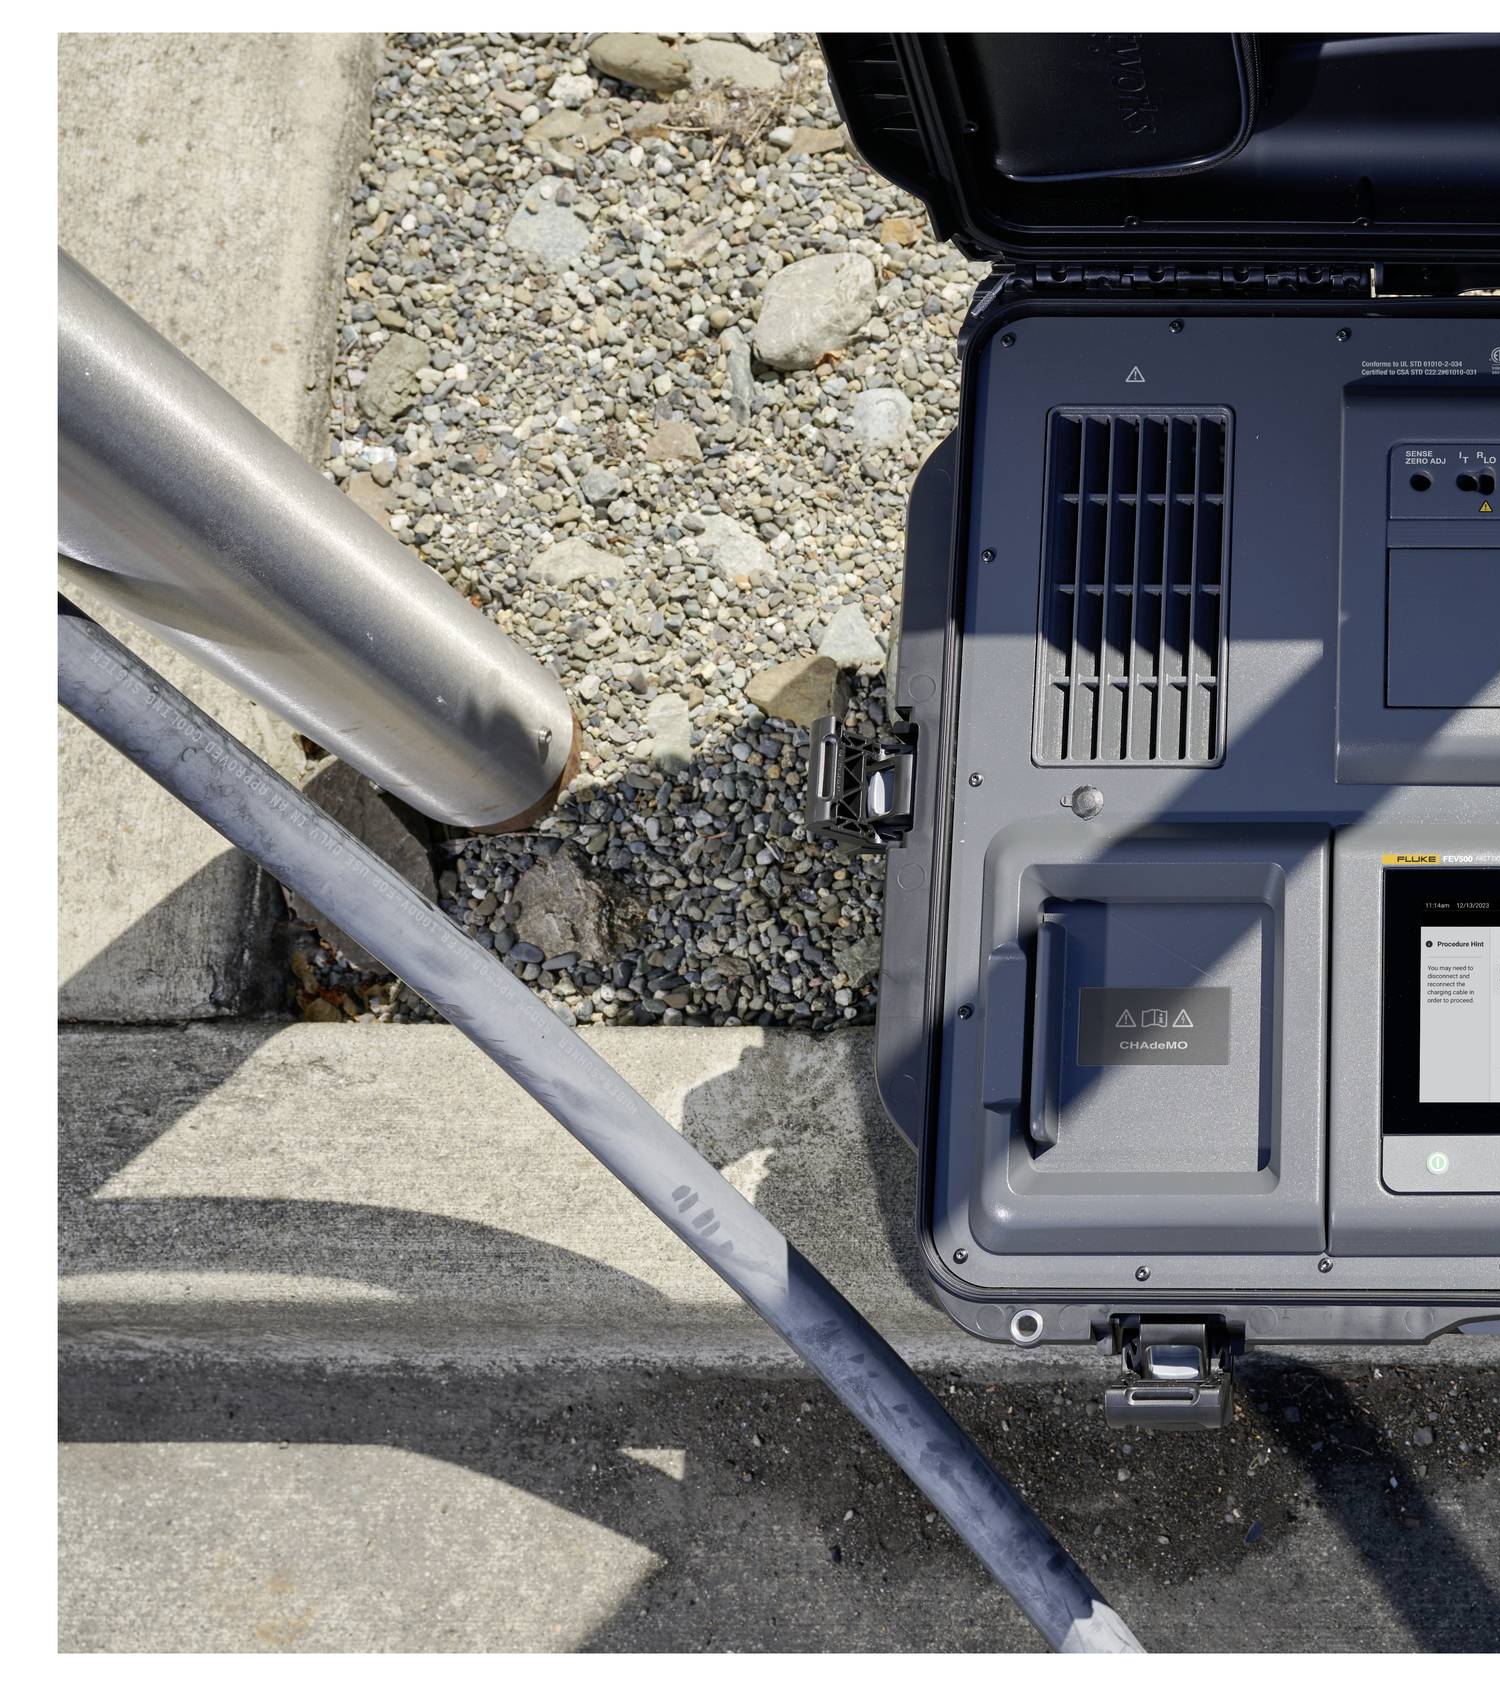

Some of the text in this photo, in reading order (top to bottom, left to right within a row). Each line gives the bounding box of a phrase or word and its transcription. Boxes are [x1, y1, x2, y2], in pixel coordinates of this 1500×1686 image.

[144, 691, 203, 743] COOLING
[202, 738, 270, 798] APPROVED
[1119, 1041, 1188, 1050] CHAdeMO
